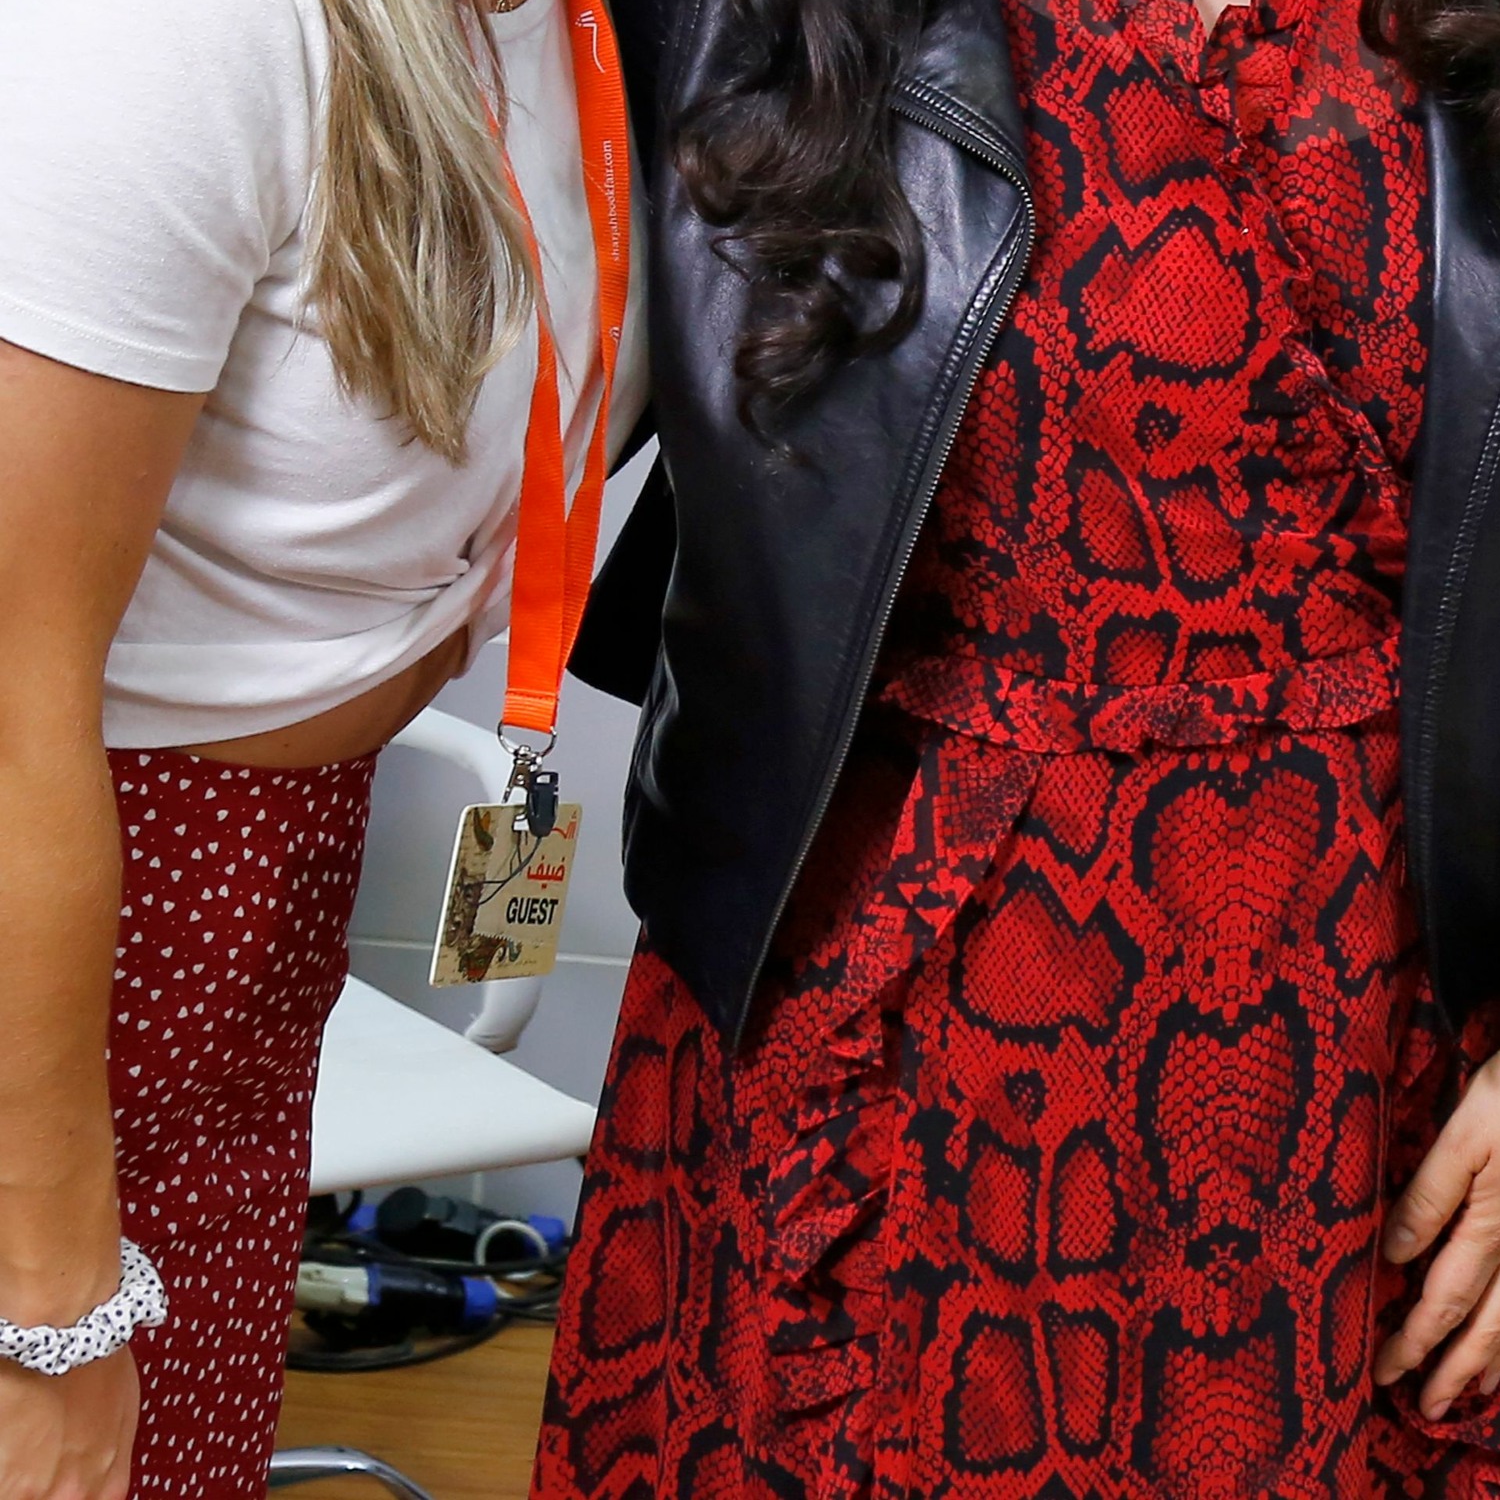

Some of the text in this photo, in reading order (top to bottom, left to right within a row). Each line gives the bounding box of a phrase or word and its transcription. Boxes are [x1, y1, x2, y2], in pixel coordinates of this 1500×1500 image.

[603, 139, 620, 262] sharjahbookfair.com
[527, 855, 565, 889] ضيف
[506, 897, 558, 925] GUEST
